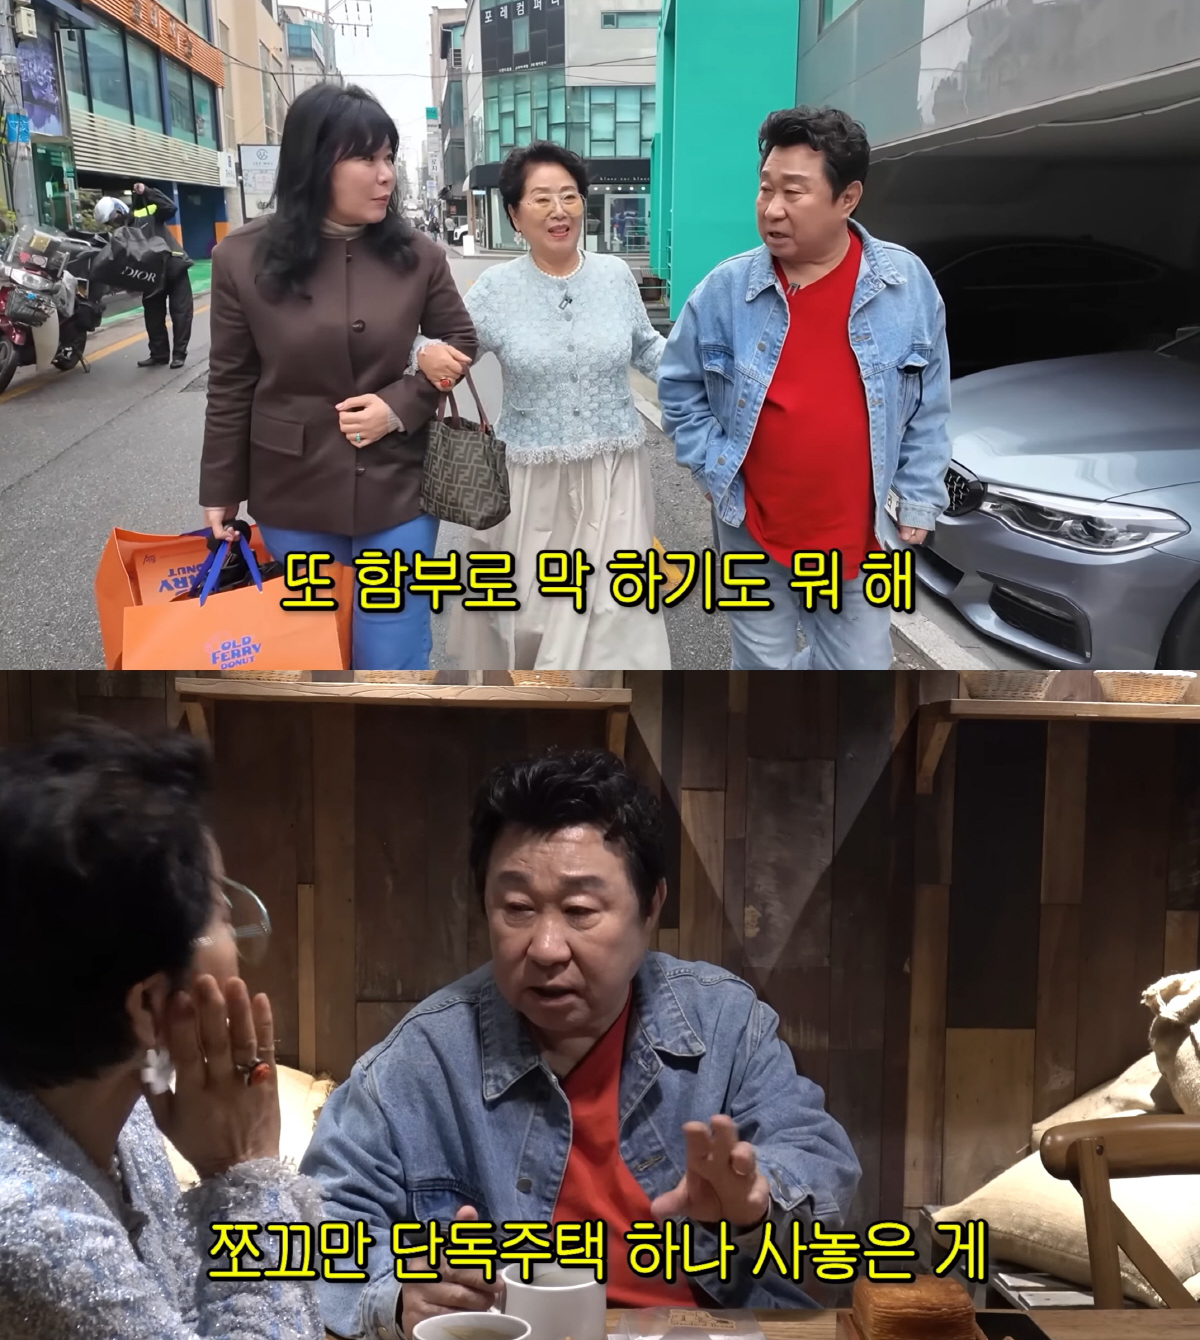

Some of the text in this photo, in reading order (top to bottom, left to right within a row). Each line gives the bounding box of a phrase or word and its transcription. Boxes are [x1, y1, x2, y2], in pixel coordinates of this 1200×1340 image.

[121, 265, 157, 283] DIOR
[168, 563, 204, 577] ONUT
[220, 635, 252, 651] OLD
[211, 643, 262, 665] FERRY
[220, 655, 255, 670] DONUT
